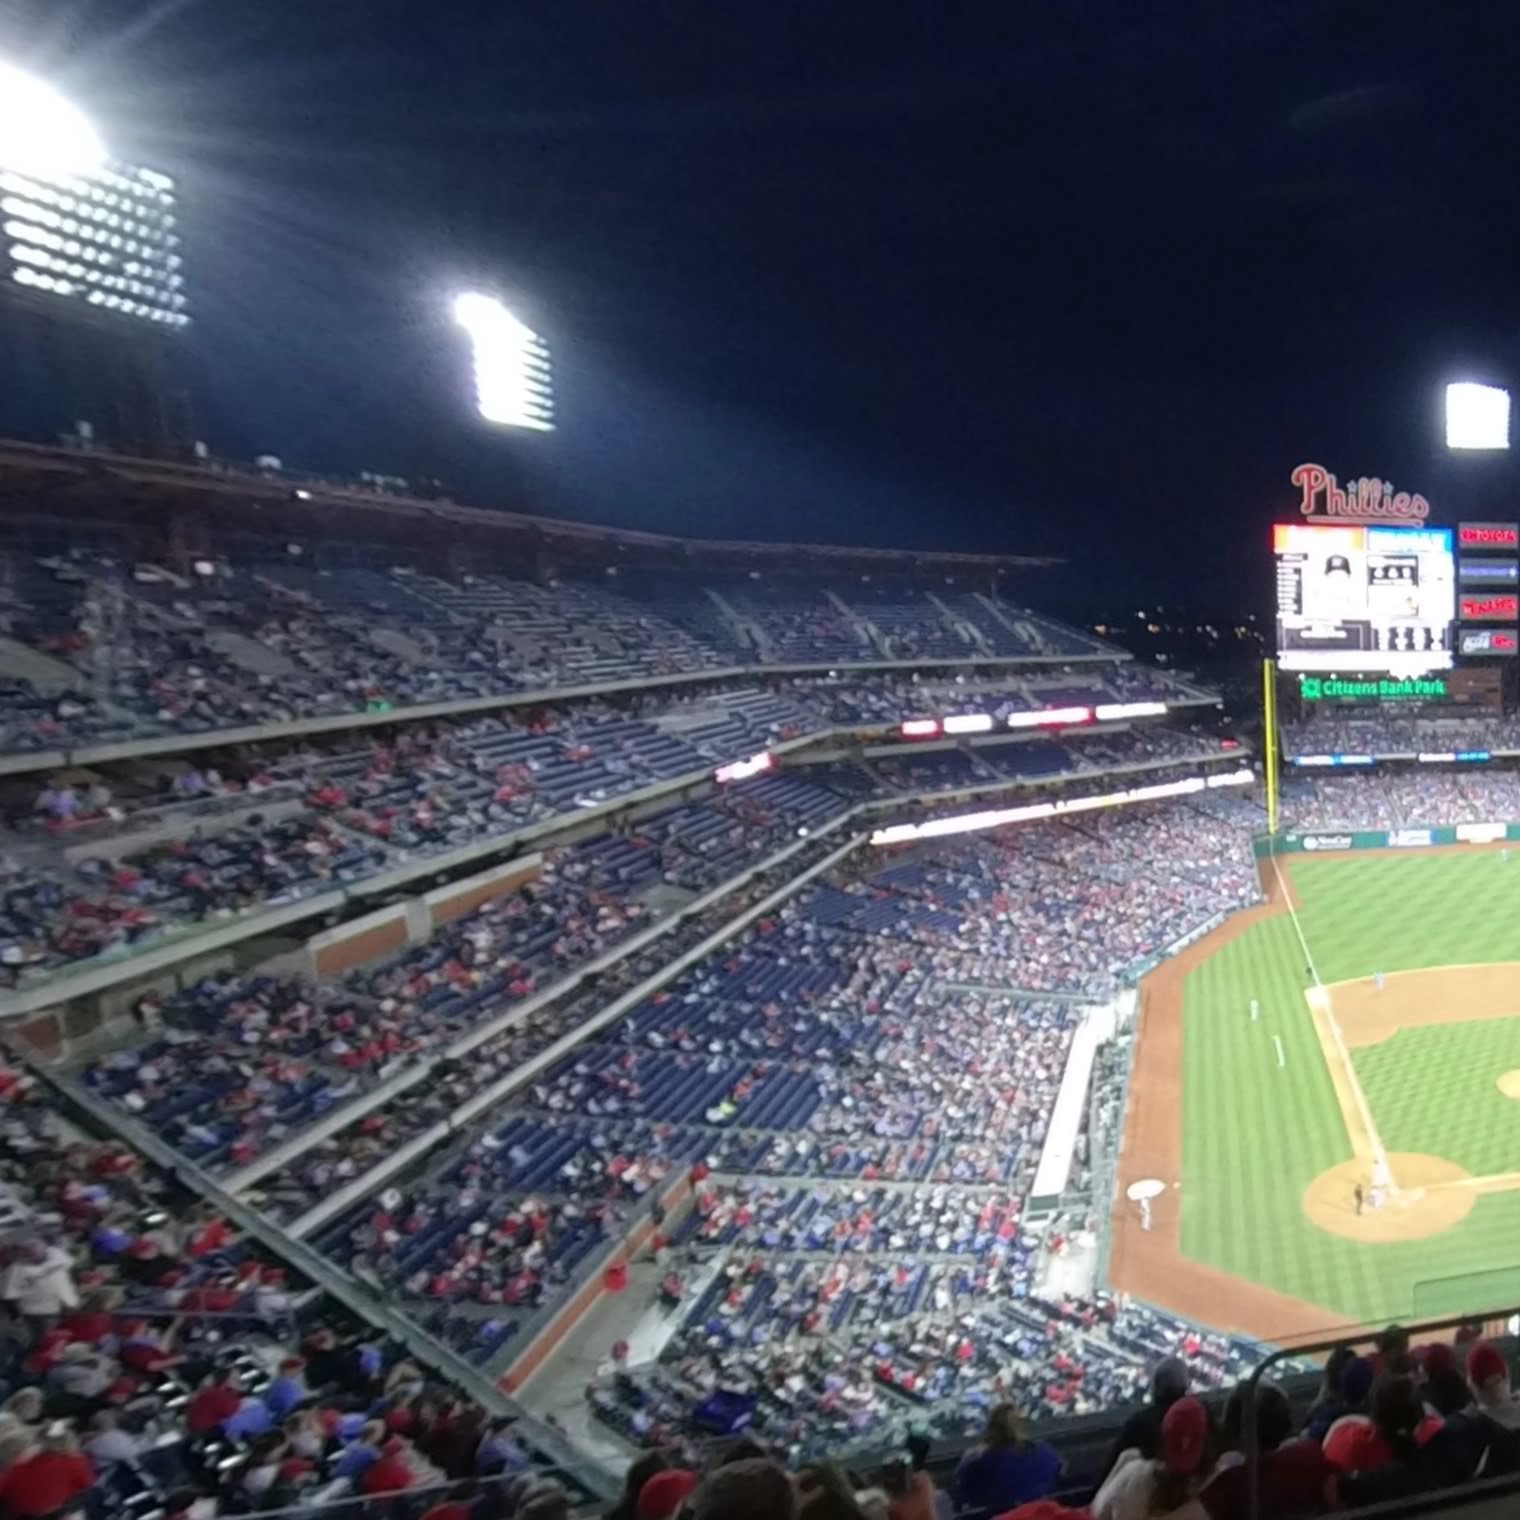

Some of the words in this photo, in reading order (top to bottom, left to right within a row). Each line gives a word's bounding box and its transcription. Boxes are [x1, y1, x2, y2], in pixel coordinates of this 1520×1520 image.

[1291, 463, 1429, 518] Phillies
[1476, 529, 1517, 542] TOYOTA
[1322, 681, 1378, 696] Citizens
[1379, 680, 1413, 695] Bank
[1415, 679, 1446, 694] Park
